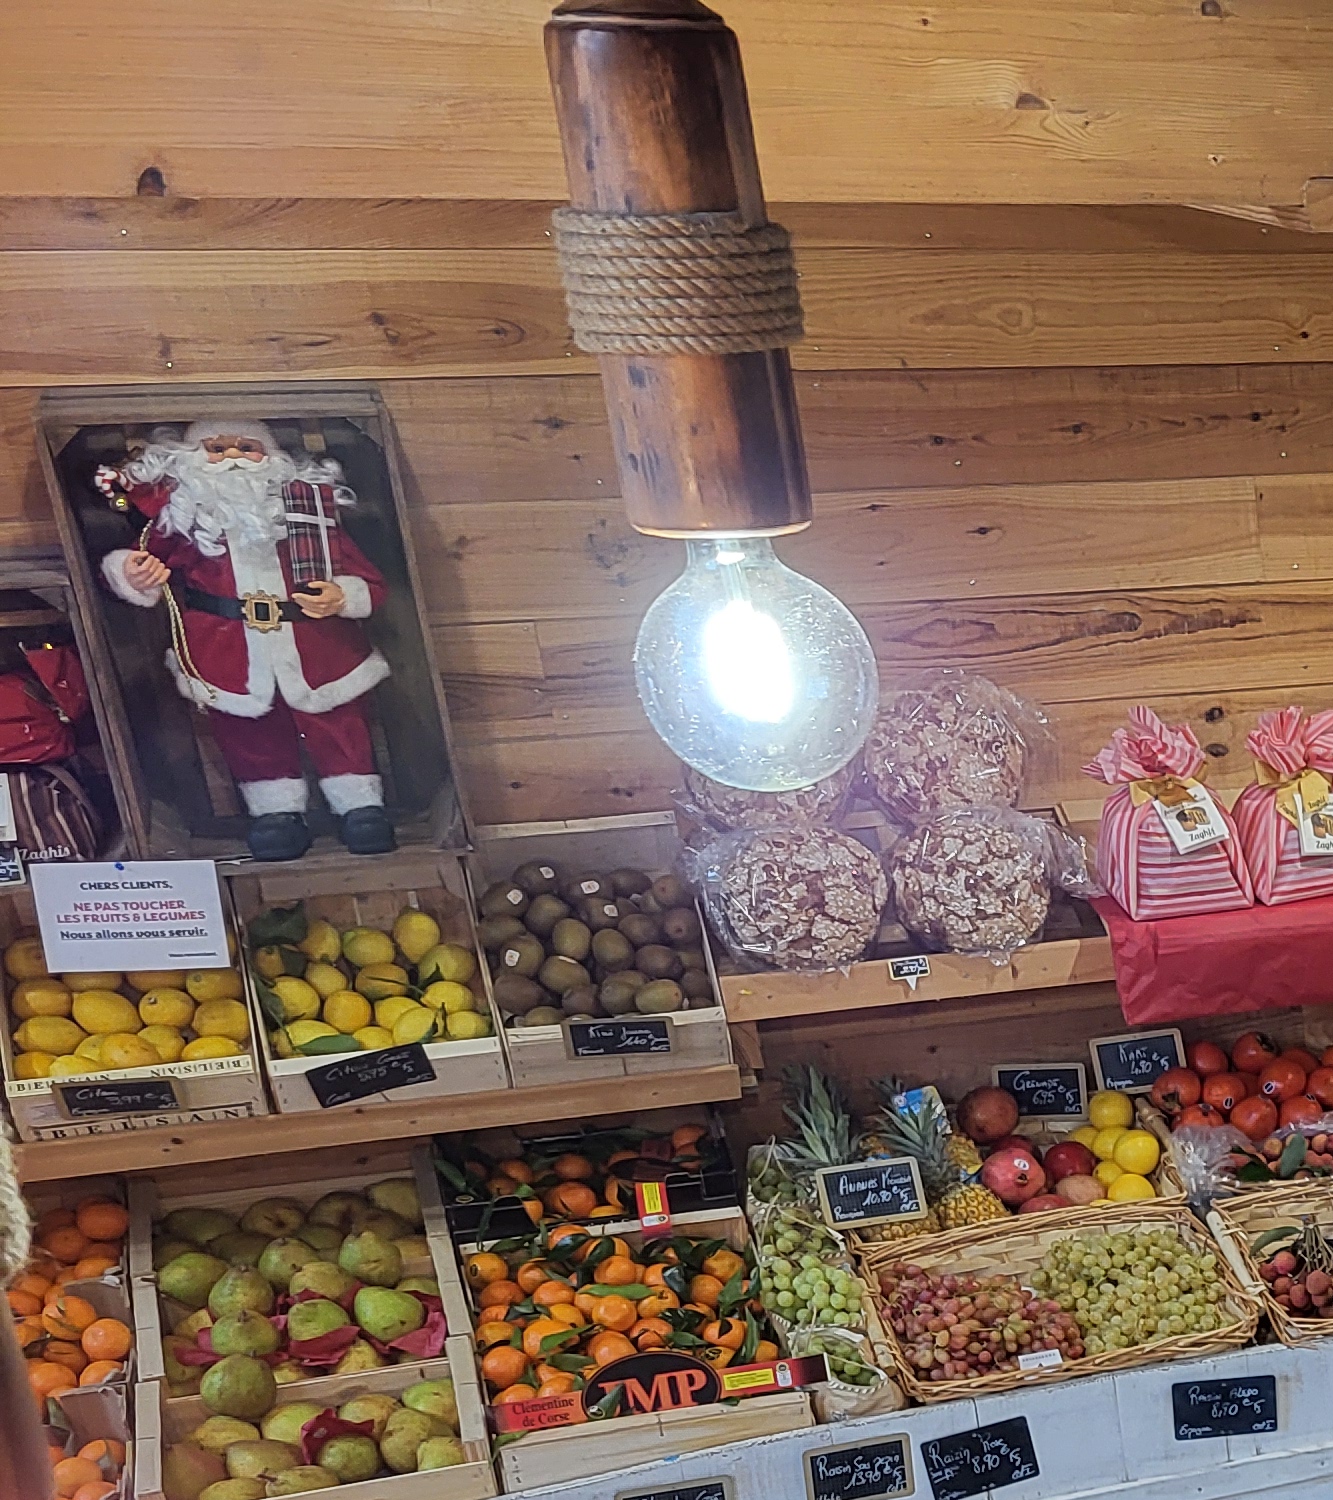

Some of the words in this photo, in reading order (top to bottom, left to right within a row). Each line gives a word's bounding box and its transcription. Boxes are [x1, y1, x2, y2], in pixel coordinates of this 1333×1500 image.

[80, 882, 119, 890] CHERS
[73, 902, 92, 911] NE
[95, 901, 120, 911] PAS
[123, 900, 186, 910] TOUCHER
[57, 914, 80, 923] LES
[84, 913, 130, 923] FRUITS
[133, 913, 140, 922] &
[144, 911, 206, 921] LEGUMES
[61, 930, 93, 940] Nous
[96, 930, 133, 939] allons
[136, 930, 166, 938] vous
[512, 1397, 574, 1415] Clémentine
[522, 1416, 536, 1427] de
[538, 1412, 570, 1424] Corse
